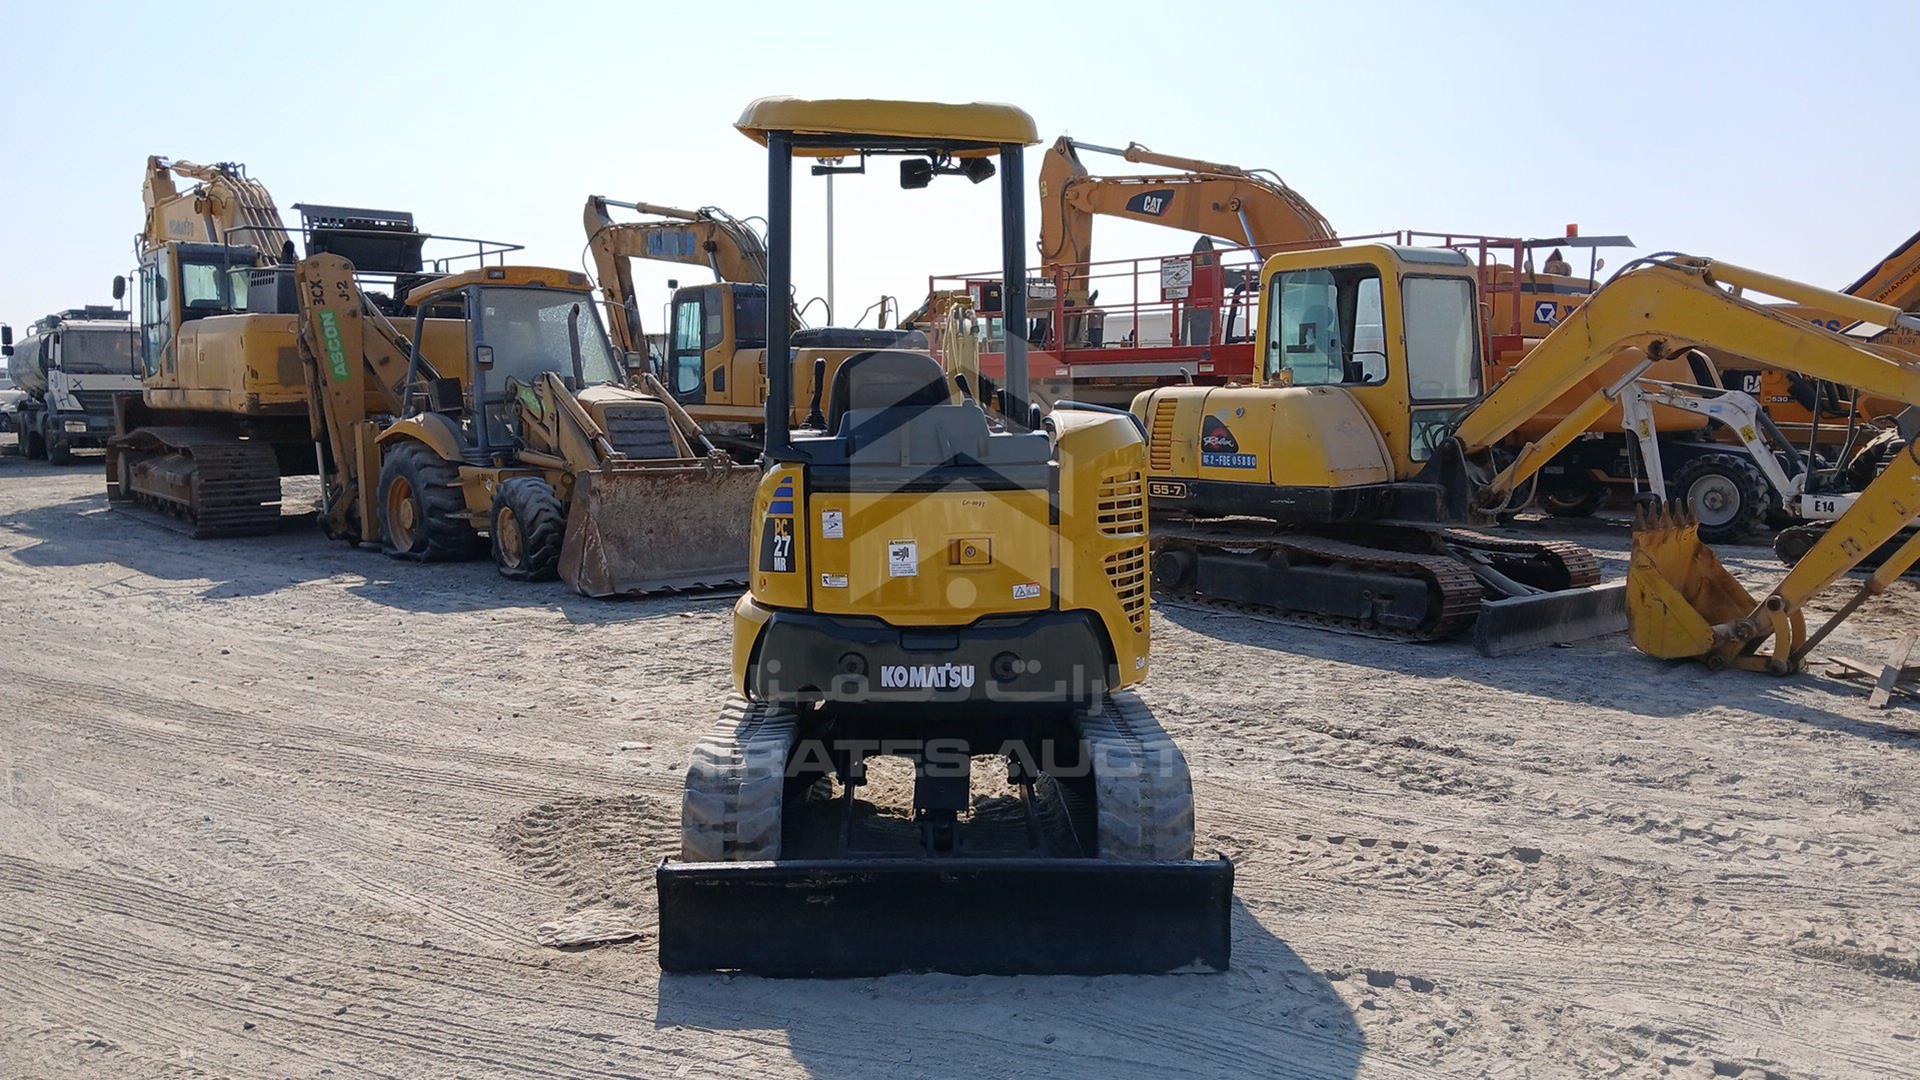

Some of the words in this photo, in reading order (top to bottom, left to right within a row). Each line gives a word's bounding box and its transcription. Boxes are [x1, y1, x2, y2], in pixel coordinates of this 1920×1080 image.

[1143, 195, 1163, 214] CAT
[320, 312, 348, 376] ASCON
[1743, 375, 1762, 393] CA
[1153, 485, 1182, 495] 55-7
[774, 518, 788, 538] PC
[773, 535, 791, 557] 27
[773, 557, 787, 572] MR
[880, 662, 975, 688] KOMATSU
